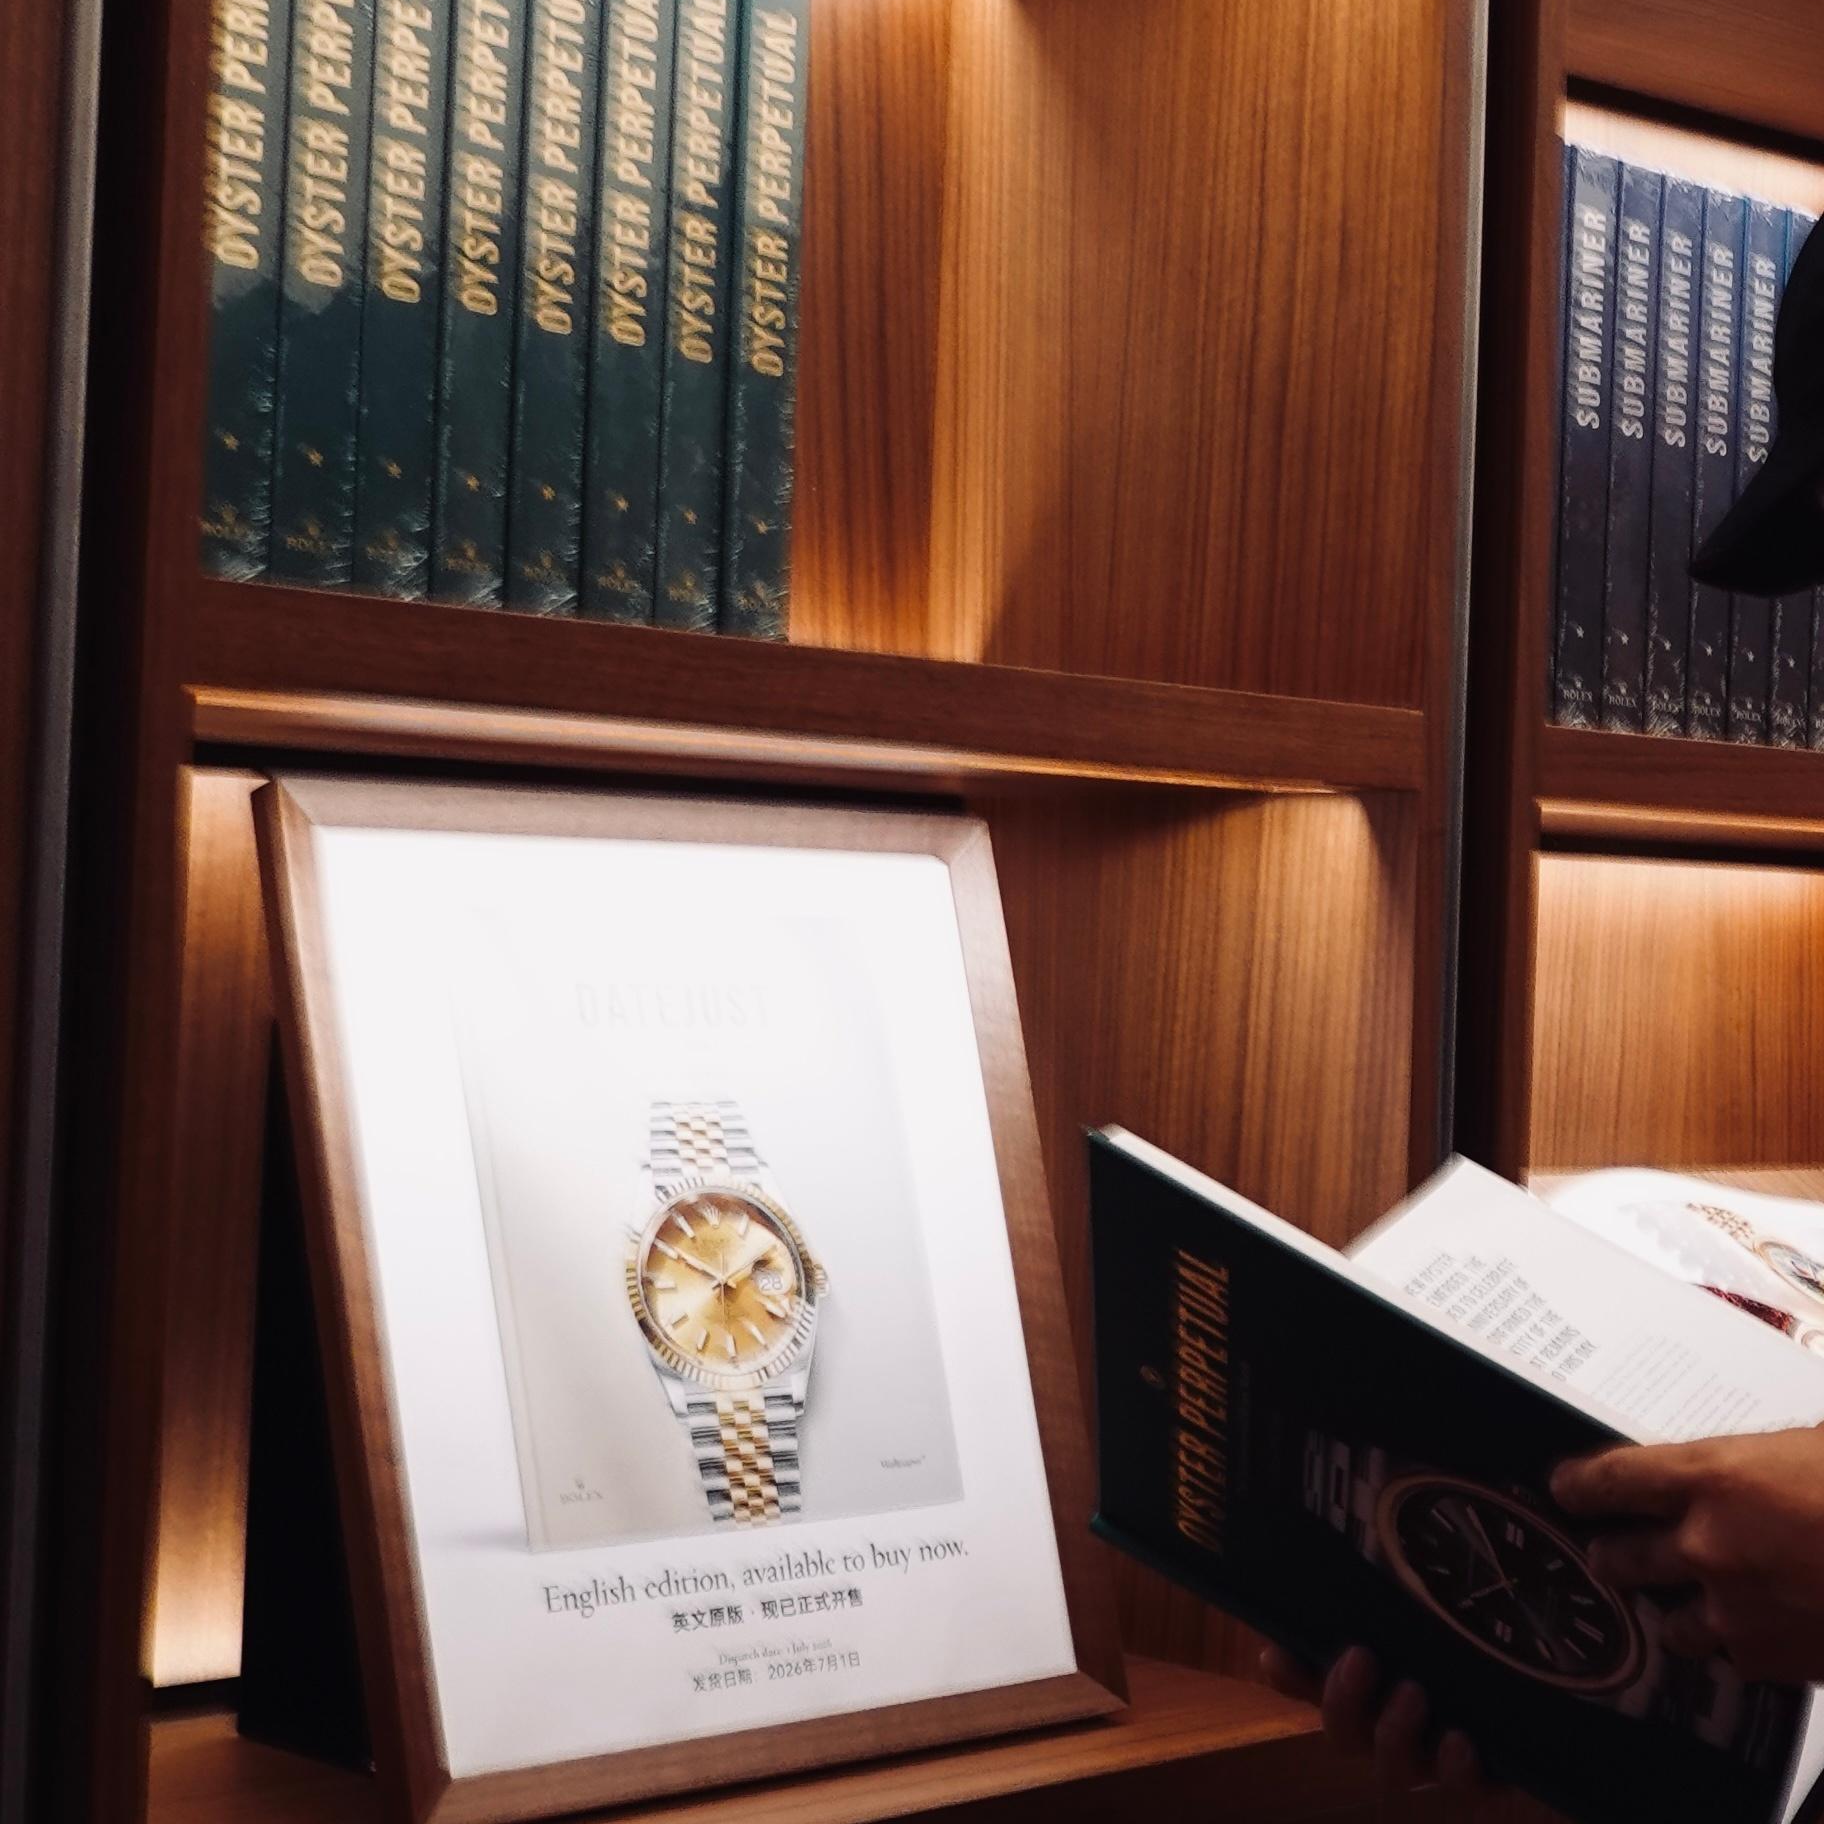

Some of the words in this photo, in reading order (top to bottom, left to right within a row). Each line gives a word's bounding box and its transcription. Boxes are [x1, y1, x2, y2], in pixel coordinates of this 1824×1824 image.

[212, 96, 265, 270] OYSTER
[754, 9, 798, 226] PERPETUAL
[298, 116, 350, 288] OYSTER
[378, 138, 427, 305] OYSTER
[458, 152, 504, 316] OYSTER
[533, 175, 579, 335] OYSTER
[606, 189, 651, 348] OYSTER
[676, 210, 718, 364] OYSTER
[749, 226, 789, 378] OYSTER
[1576, 209, 1607, 431] SUBMARINER
[1620, 221, 1651, 440] SUBMARINER
[1664, 233, 1694, 449] SUBMARINER
[1706, 245, 1734, 458] SUBMARINER
[1563, 689, 1593, 703] ROLEX
[1608, 695, 1637, 708] ROLEX
[1694, 704, 1721, 718] ROLEX
[1736, 709, 1762, 723] ROLEX
[574, 981, 770, 1030] DATEJUST
[760, 1275, 784, 1292] 28
[1174, 1246, 1230, 1444] PERPETUAL
[1175, 1429, 1226, 1556] OYSTER
[543, 1581, 637, 1619] English
[644, 1567, 736, 1600] edition,
[742, 1549, 835, 1587] available
[843, 1550, 865, 1573] to
[871, 1543, 912, 1574] buy
[919, 1537, 970, 1562] now.
[671, 1604, 744, 1633] 英文原版
[760, 1587, 864, 1620] 现已正式开售
[768, 1651, 862, 1682] 2026年7月1日
